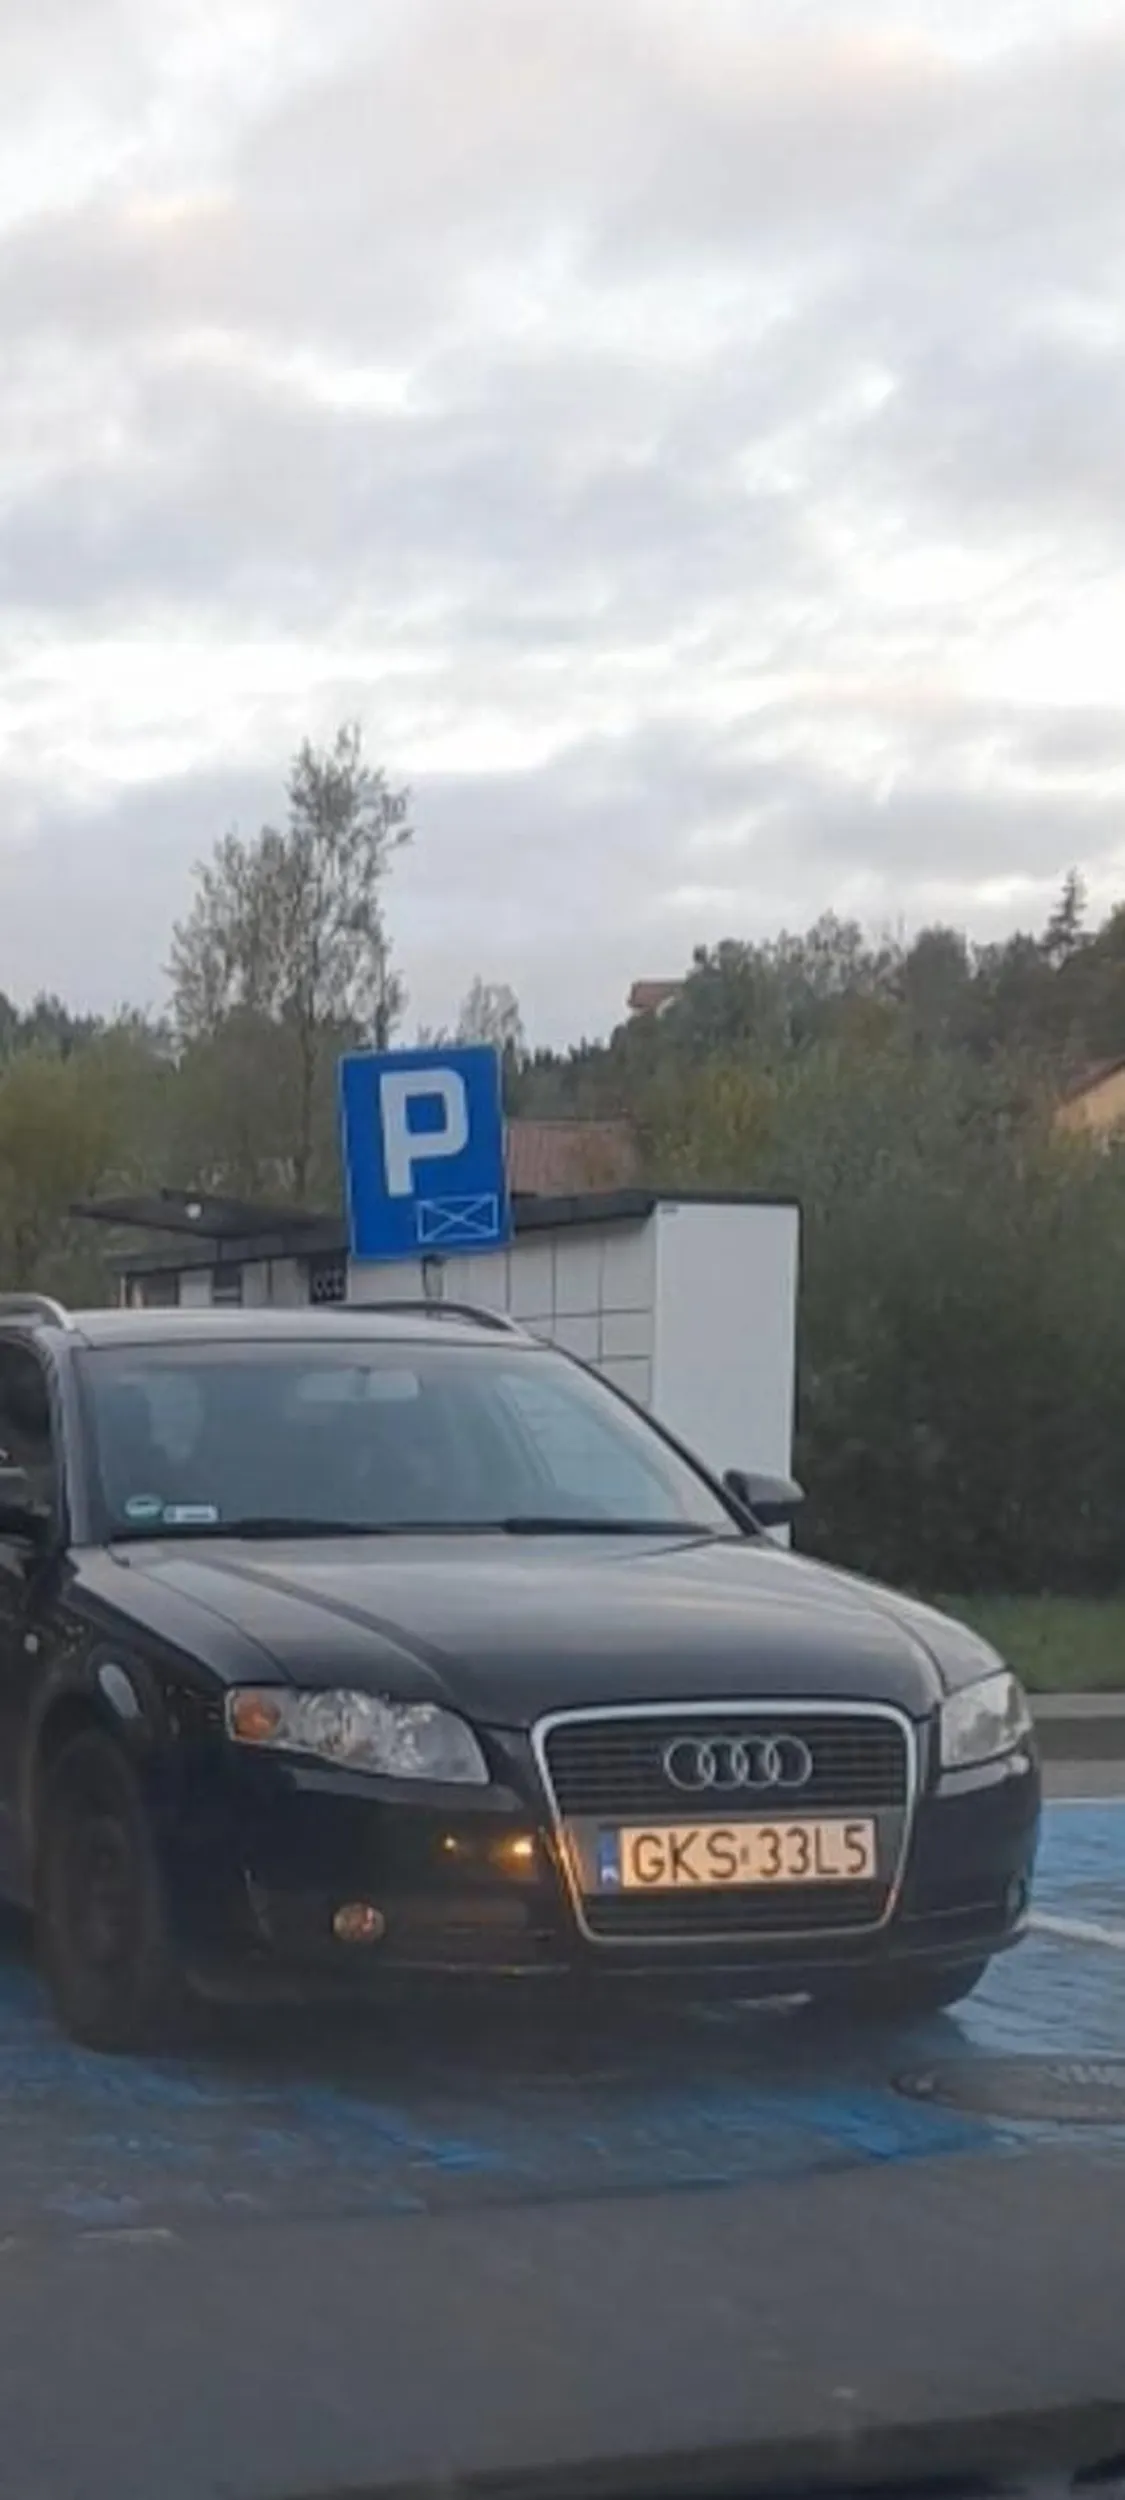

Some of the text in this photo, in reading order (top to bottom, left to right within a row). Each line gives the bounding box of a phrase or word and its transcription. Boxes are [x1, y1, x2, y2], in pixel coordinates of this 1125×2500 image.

[380, 1067, 468, 1197] P
[631, 1824, 867, 1882] GKS 33L5
